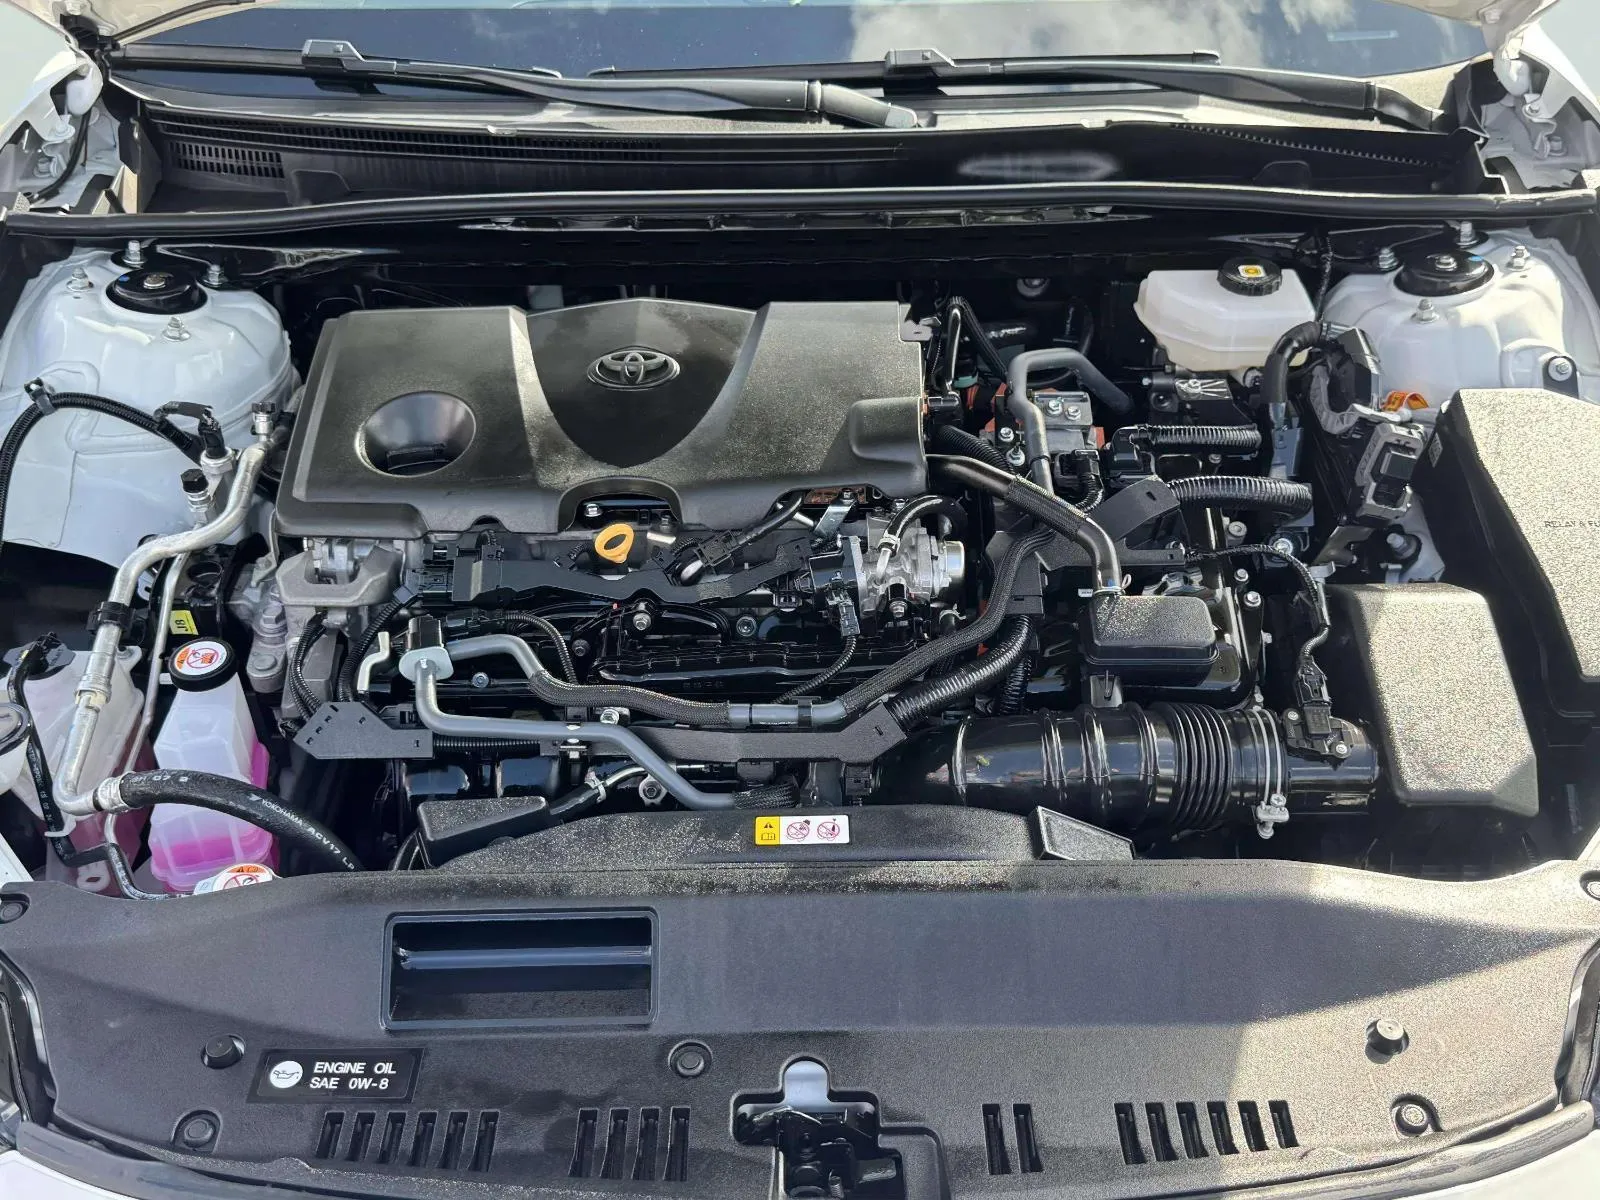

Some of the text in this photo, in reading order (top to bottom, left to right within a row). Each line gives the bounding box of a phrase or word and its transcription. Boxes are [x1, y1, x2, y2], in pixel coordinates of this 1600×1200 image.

[261, 799, 303, 827] YOKOHAMA
[307, 826, 341, 854] ACV17
[313, 1061, 397, 1075] ENGINE OIL
[309, 1076, 389, 1090] SAE 0W-8
